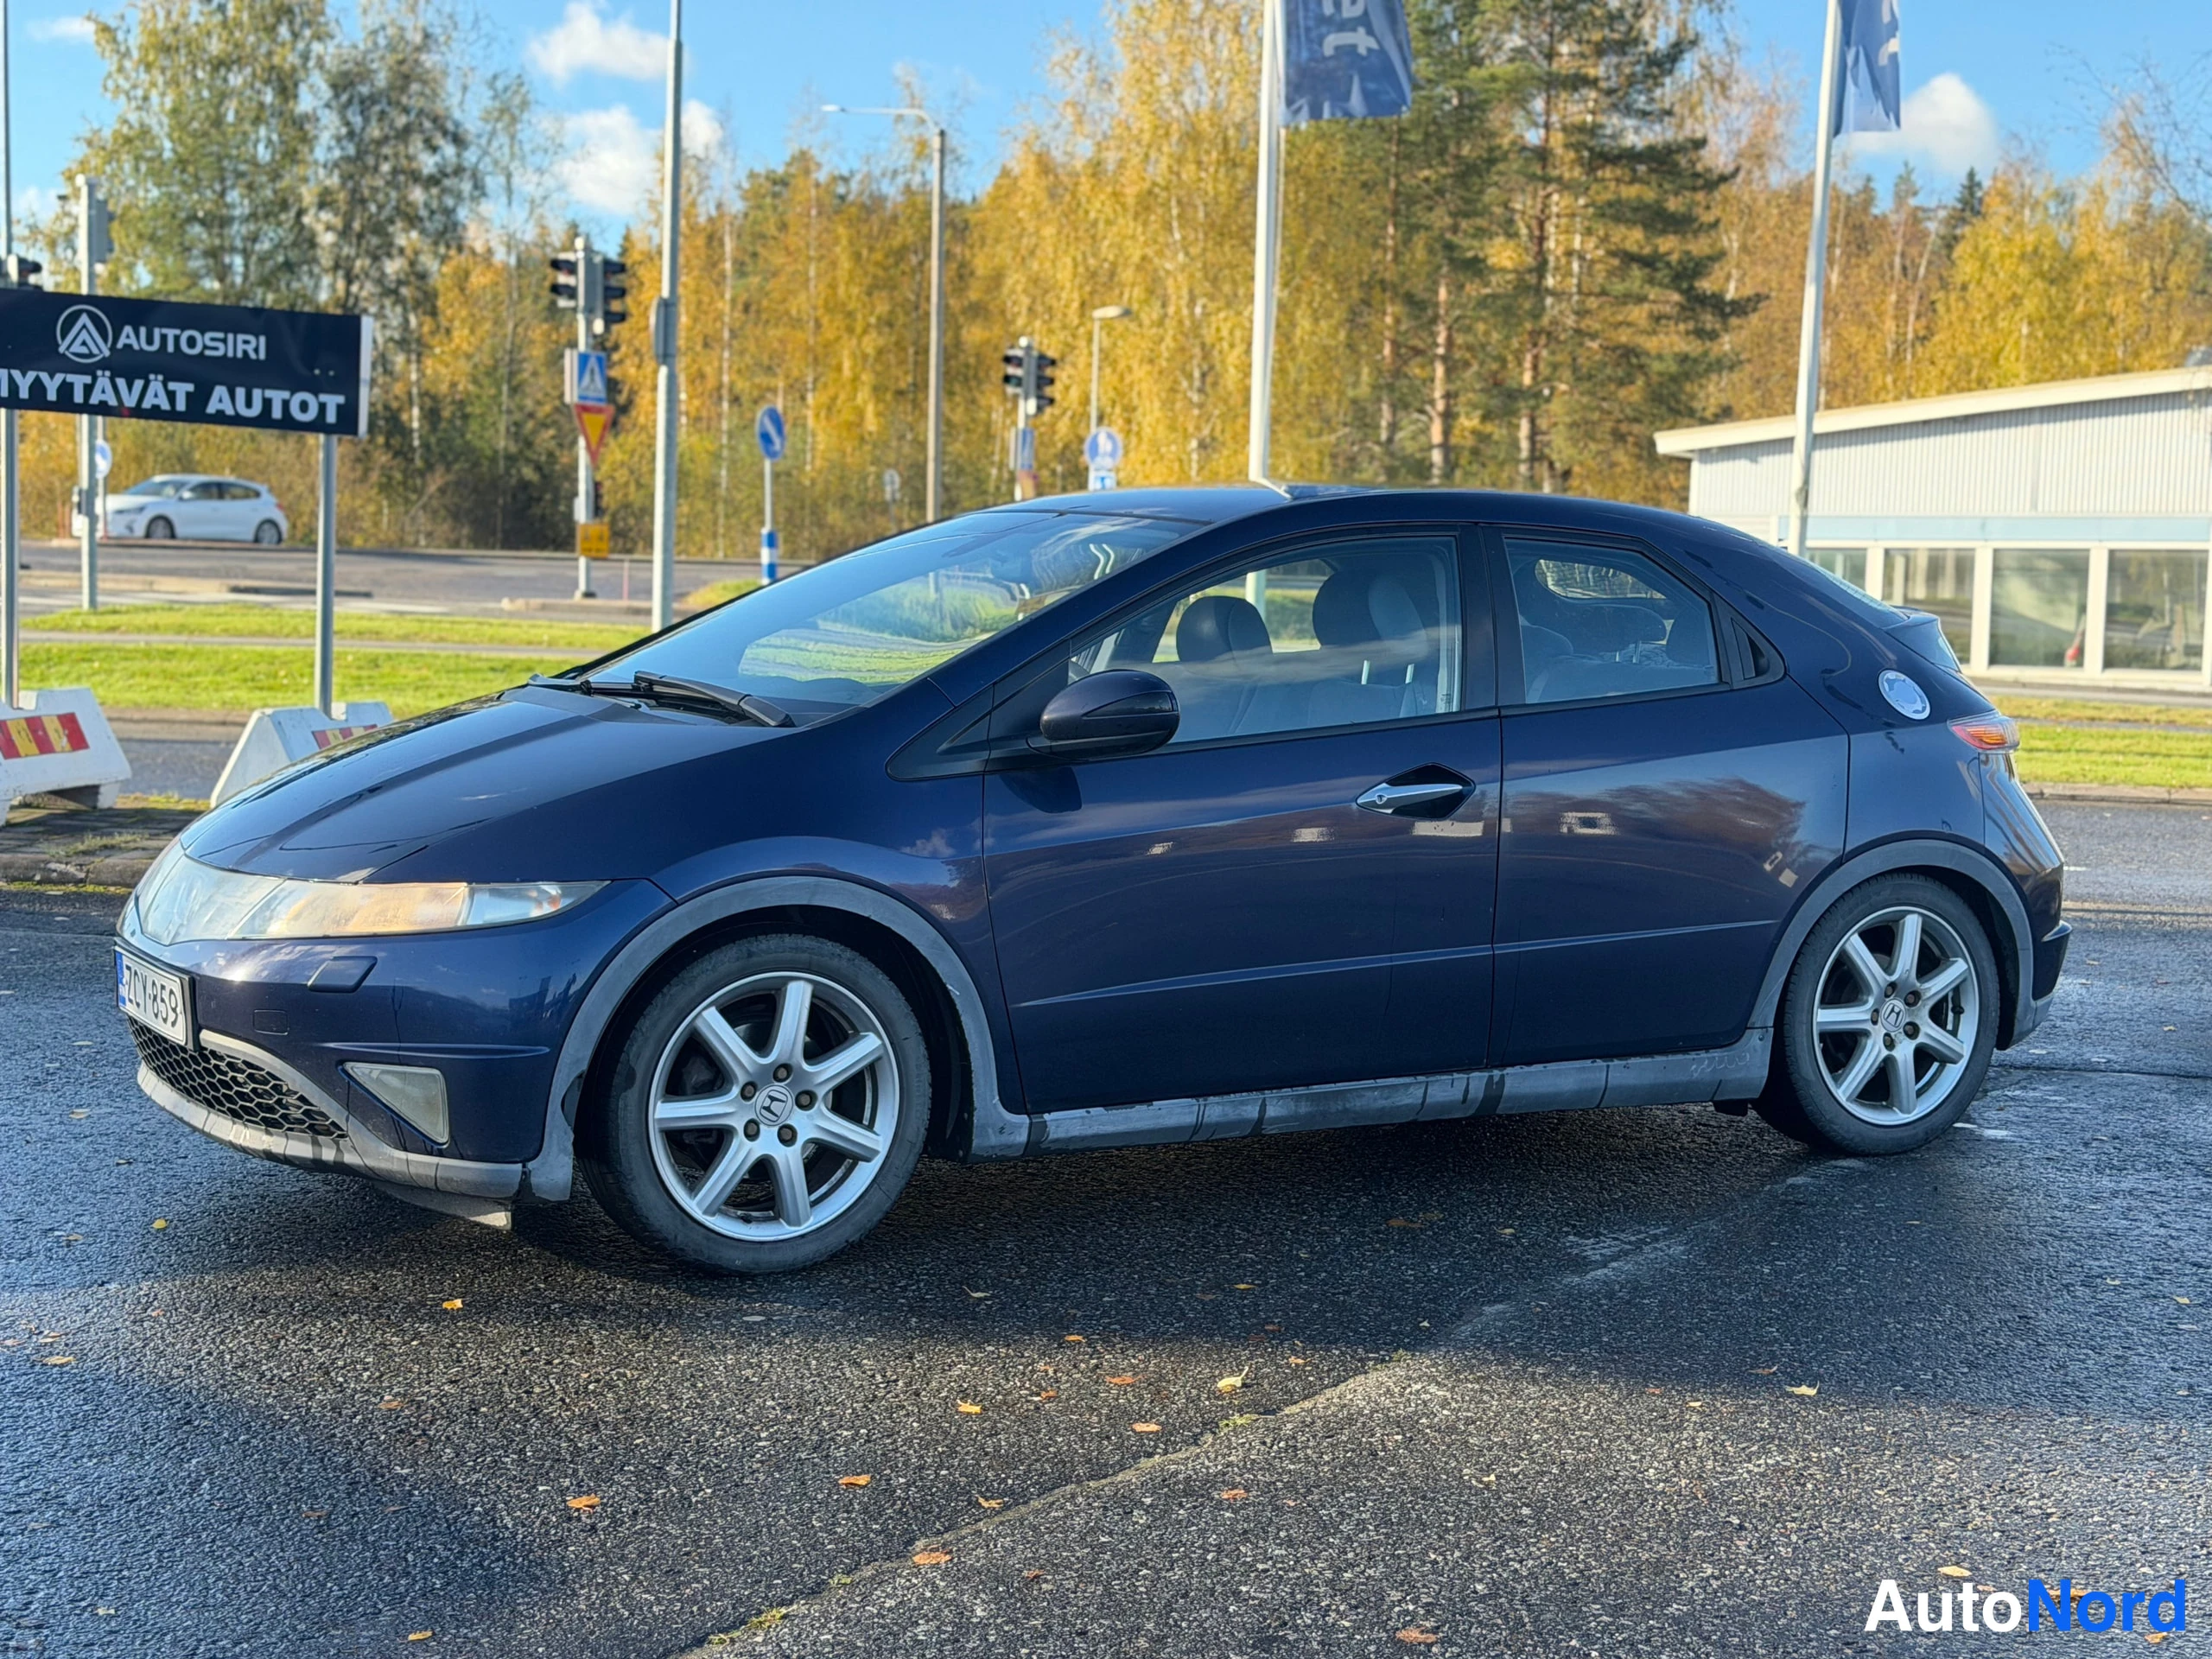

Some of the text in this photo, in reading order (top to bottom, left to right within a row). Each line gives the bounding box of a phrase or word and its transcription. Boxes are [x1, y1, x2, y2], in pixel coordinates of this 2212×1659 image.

[116, 325, 266, 360] AUTOSIRI
[206, 385, 346, 423] AUTOT
[125, 965, 178, 1027] ZCY-859
